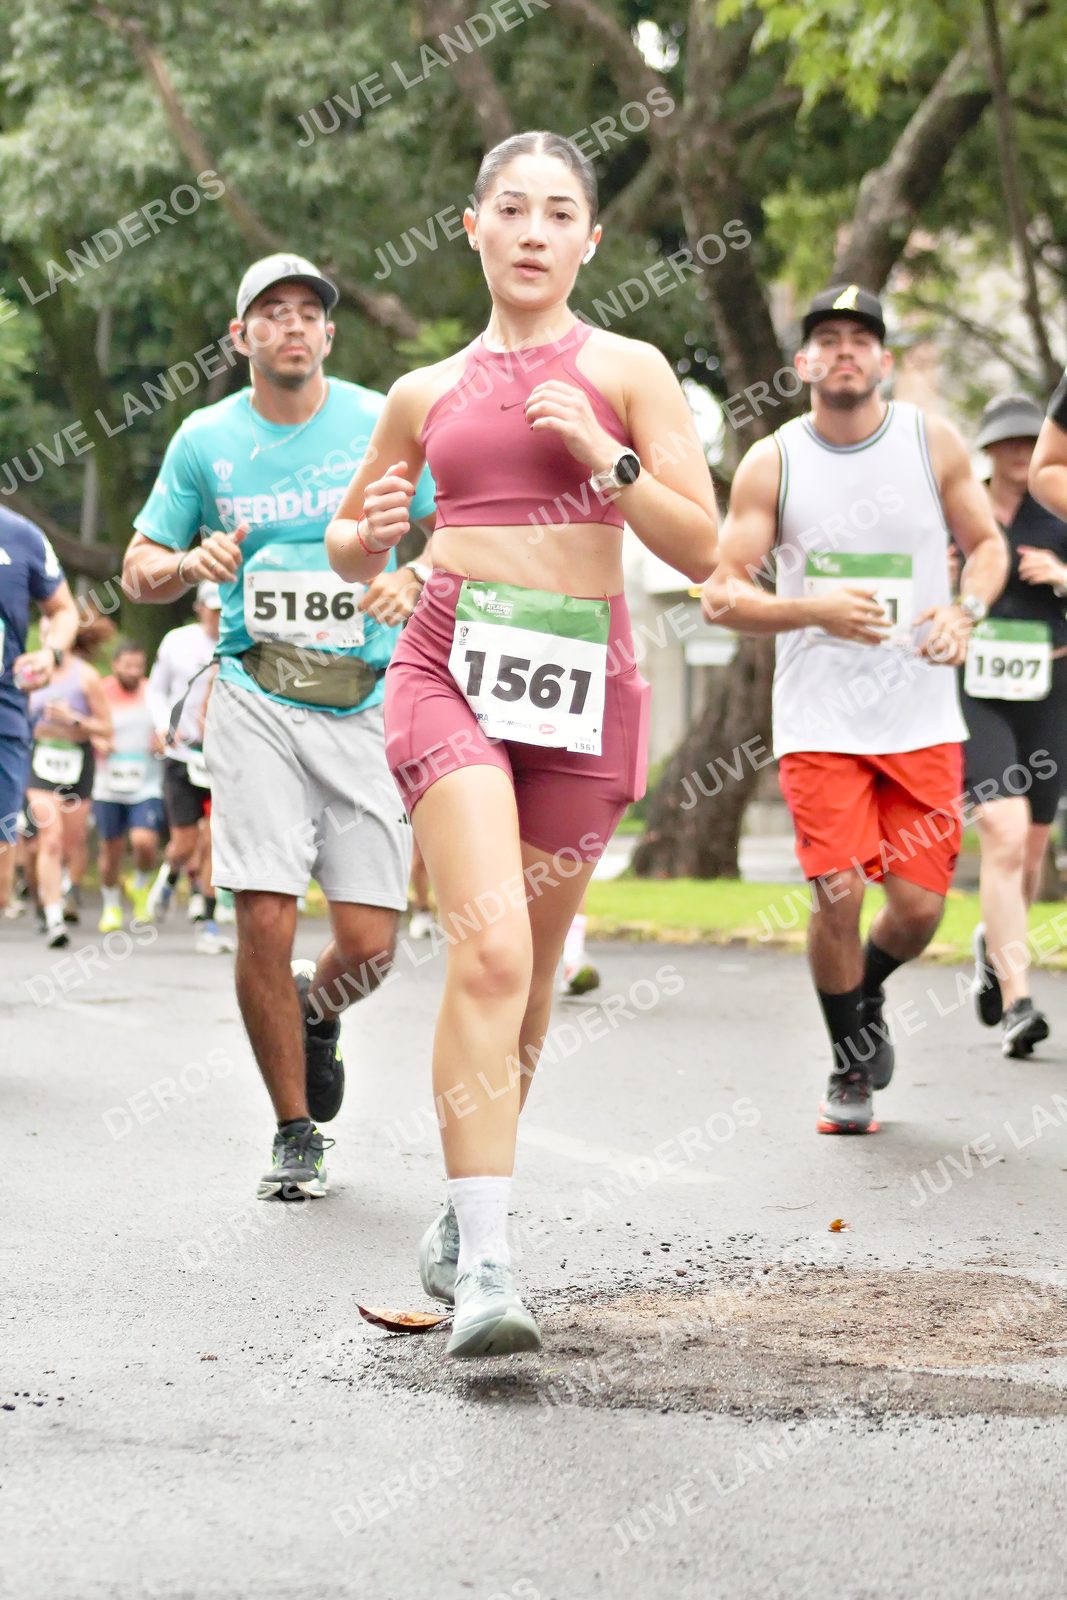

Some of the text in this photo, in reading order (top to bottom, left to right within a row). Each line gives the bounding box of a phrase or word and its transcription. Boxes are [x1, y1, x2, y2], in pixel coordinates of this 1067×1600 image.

[253, 591, 355, 621] 5186
[975, 655, 1041, 680] 1907
[463, 649, 592, 715] 1561
[575, 742, 595, 752] 1561
